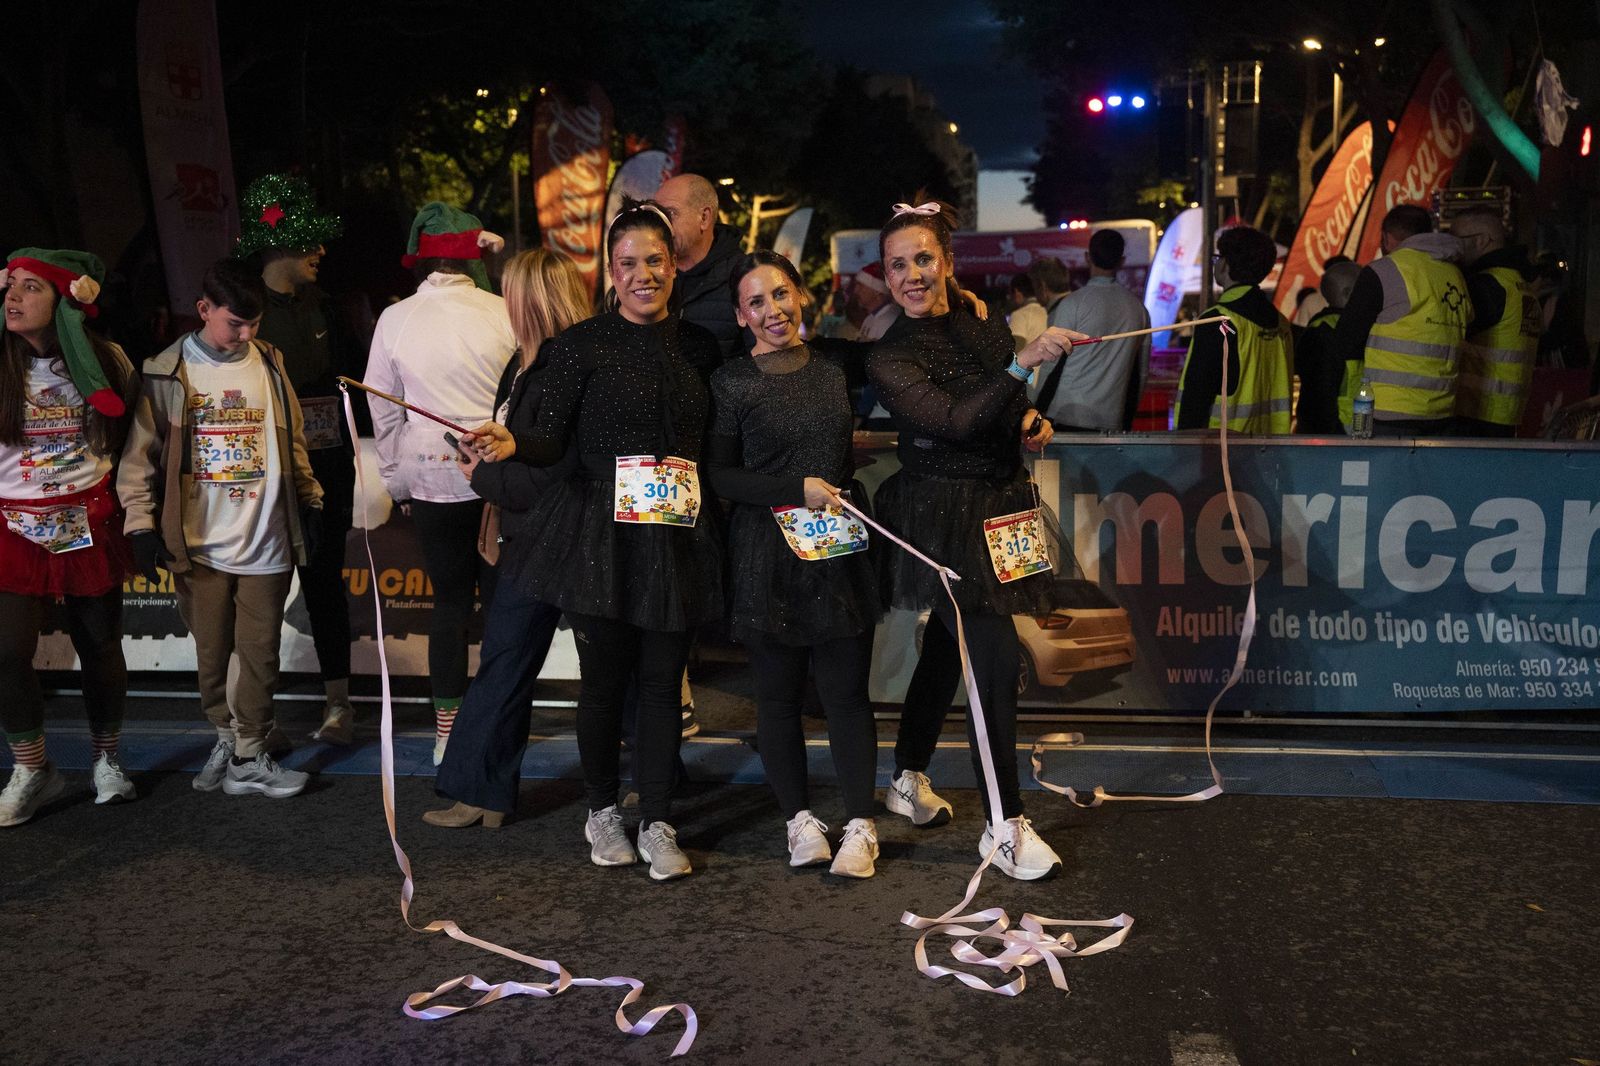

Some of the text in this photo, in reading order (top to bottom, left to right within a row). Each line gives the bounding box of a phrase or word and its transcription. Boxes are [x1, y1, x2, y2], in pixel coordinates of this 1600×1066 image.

[22, 421, 47, 430] iudad
[211, 448, 252, 462] 2163
[644, 483, 678, 499] 301
[23, 524, 67, 538] 2271
[804, 518, 840, 537] 302
[1034, 459, 1600, 595] lmericar
[1006, 537, 1030, 556] 312
[123, 597, 171, 609] scripciones
[1269, 608, 1300, 639] de
[1307, 609, 1367, 641] todo
[1374, 611, 1427, 649] tipo
[1436, 613, 1469, 644] de
[1476, 612, 1600, 649] Vehículo
[1456, 659, 1516, 676] Almería:
[1520, 658, 1551, 676] 950
[1556, 657, 1589, 676] 234
[1167, 666, 1358, 687] www.americar.com
[1393, 681, 1593, 700] Roquetas de Mar: 950 334
